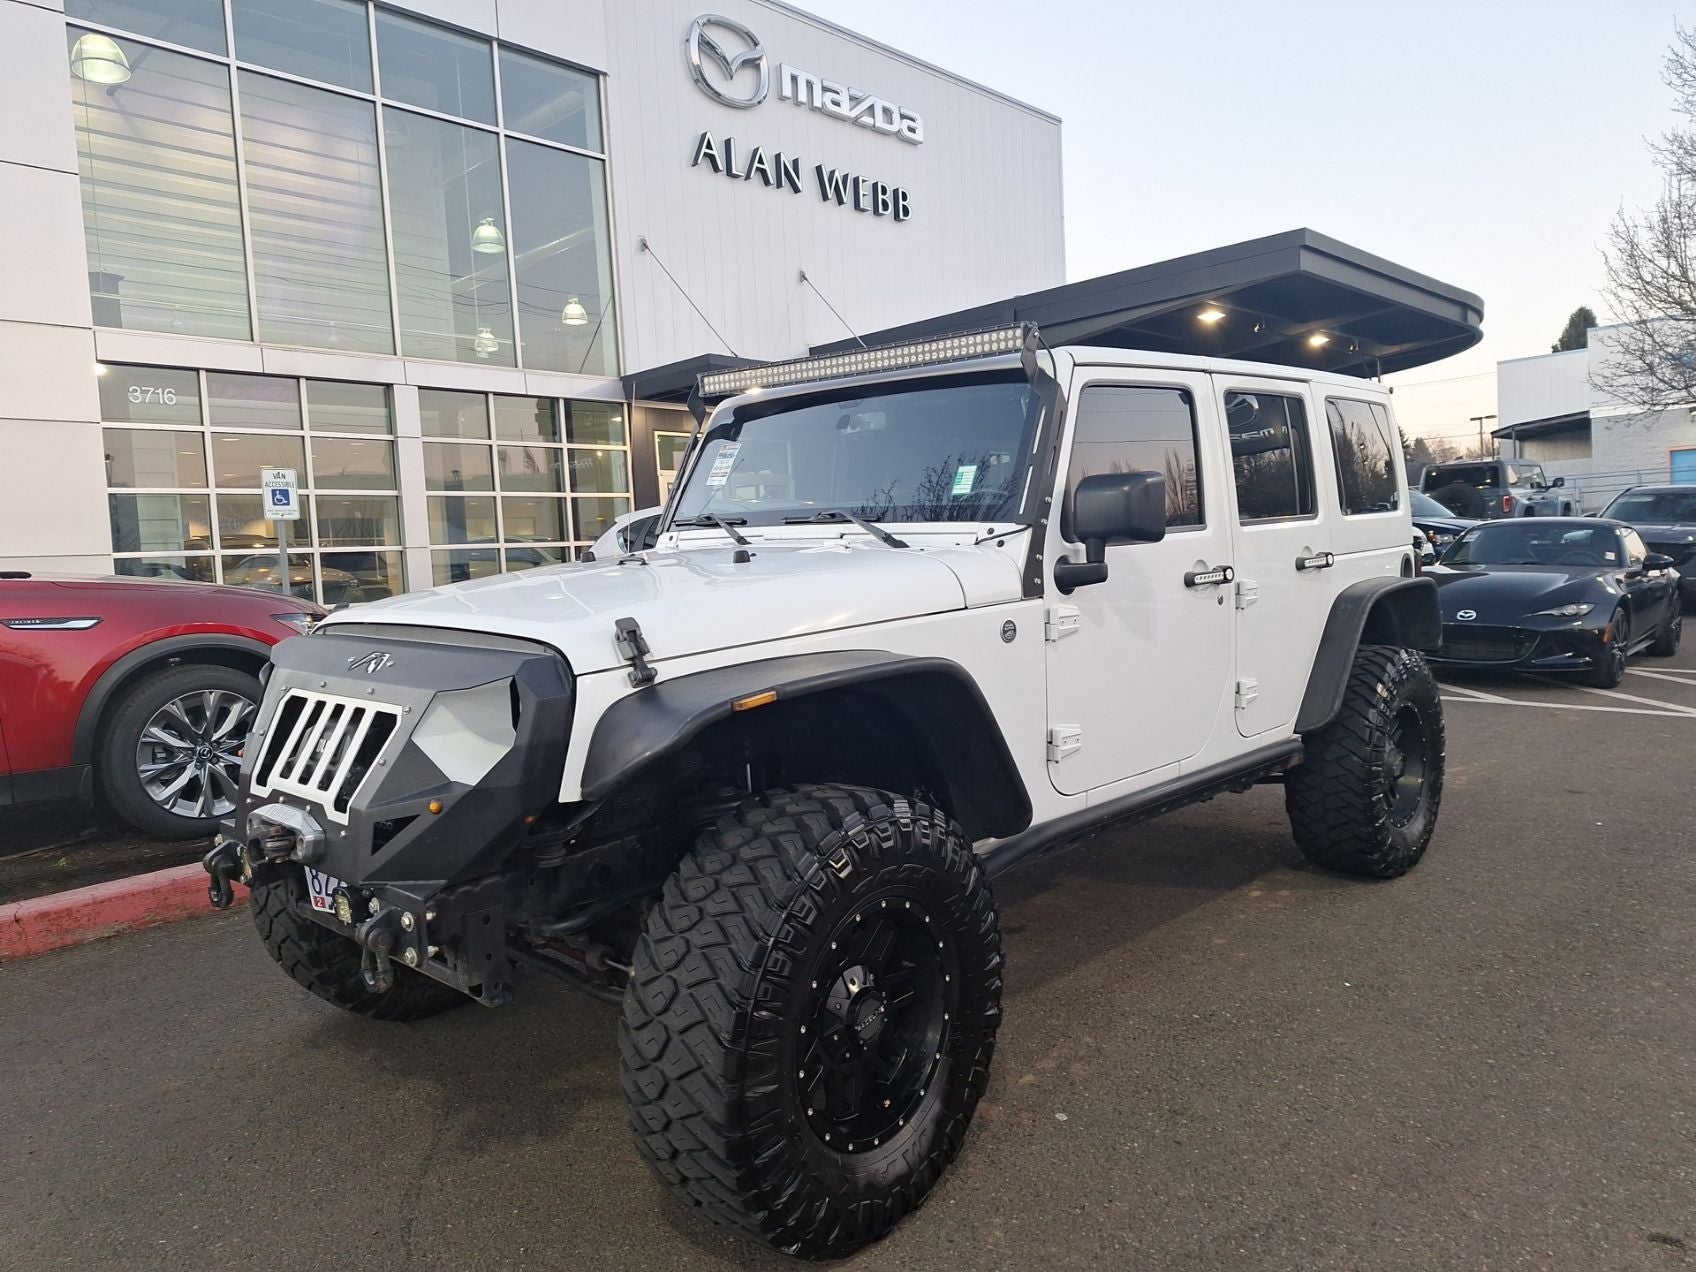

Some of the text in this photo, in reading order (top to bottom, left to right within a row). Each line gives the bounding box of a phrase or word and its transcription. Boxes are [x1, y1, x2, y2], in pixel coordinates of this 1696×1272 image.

[691, 130, 912, 222] ALAN WEBB
[128, 385, 176, 405] 3716
[272, 471, 286, 480] VAN
[264, 481, 295, 489] ACCESSIBLE
[316, 897, 323, 907] 2
